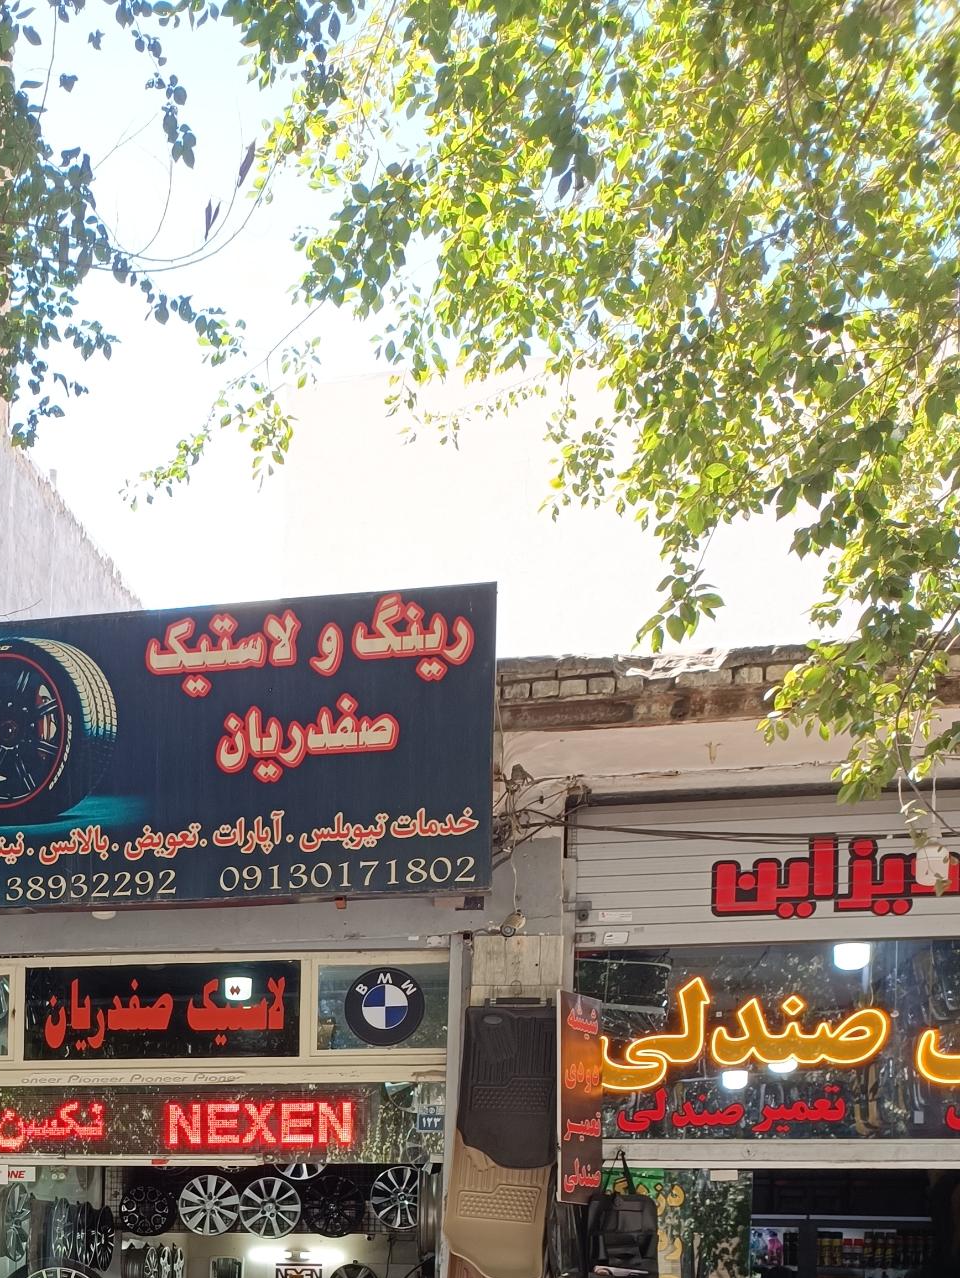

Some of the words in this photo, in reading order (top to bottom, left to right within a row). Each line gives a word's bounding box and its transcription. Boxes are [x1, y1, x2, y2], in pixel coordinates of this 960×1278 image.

[145, 609, 301, 698] لاستیک
[309, 622, 343, 677] و
[352, 594, 474, 681] رینگ
[216, 693, 400, 782] صفدریان
[39, 824, 109, 865] بالانس
[124, 823, 202, 859] تعویض
[212, 810, 285, 854] آپارات
[299, 812, 389, 852] تیوبلس
[390, 807, 479, 839] خدمات
[219, 856, 476, 892] 09130171802
[355, 972, 417, 996] BMW
[44, 978, 174, 1050] صفدریان
[187, 976, 286, 1046] لاستیک
[601, 976, 890, 1092] صندلی
[67, 1074, 124, 1084] Pioneer
[129, 1073, 188, 1084] Pioneer
[167, 1101, 353, 1145] NEXEN
[617, 1087, 744, 1133] صندلی
[752, 1085, 846, 1132] تعمیر
[564, 1158, 601, 1192] صندلی
